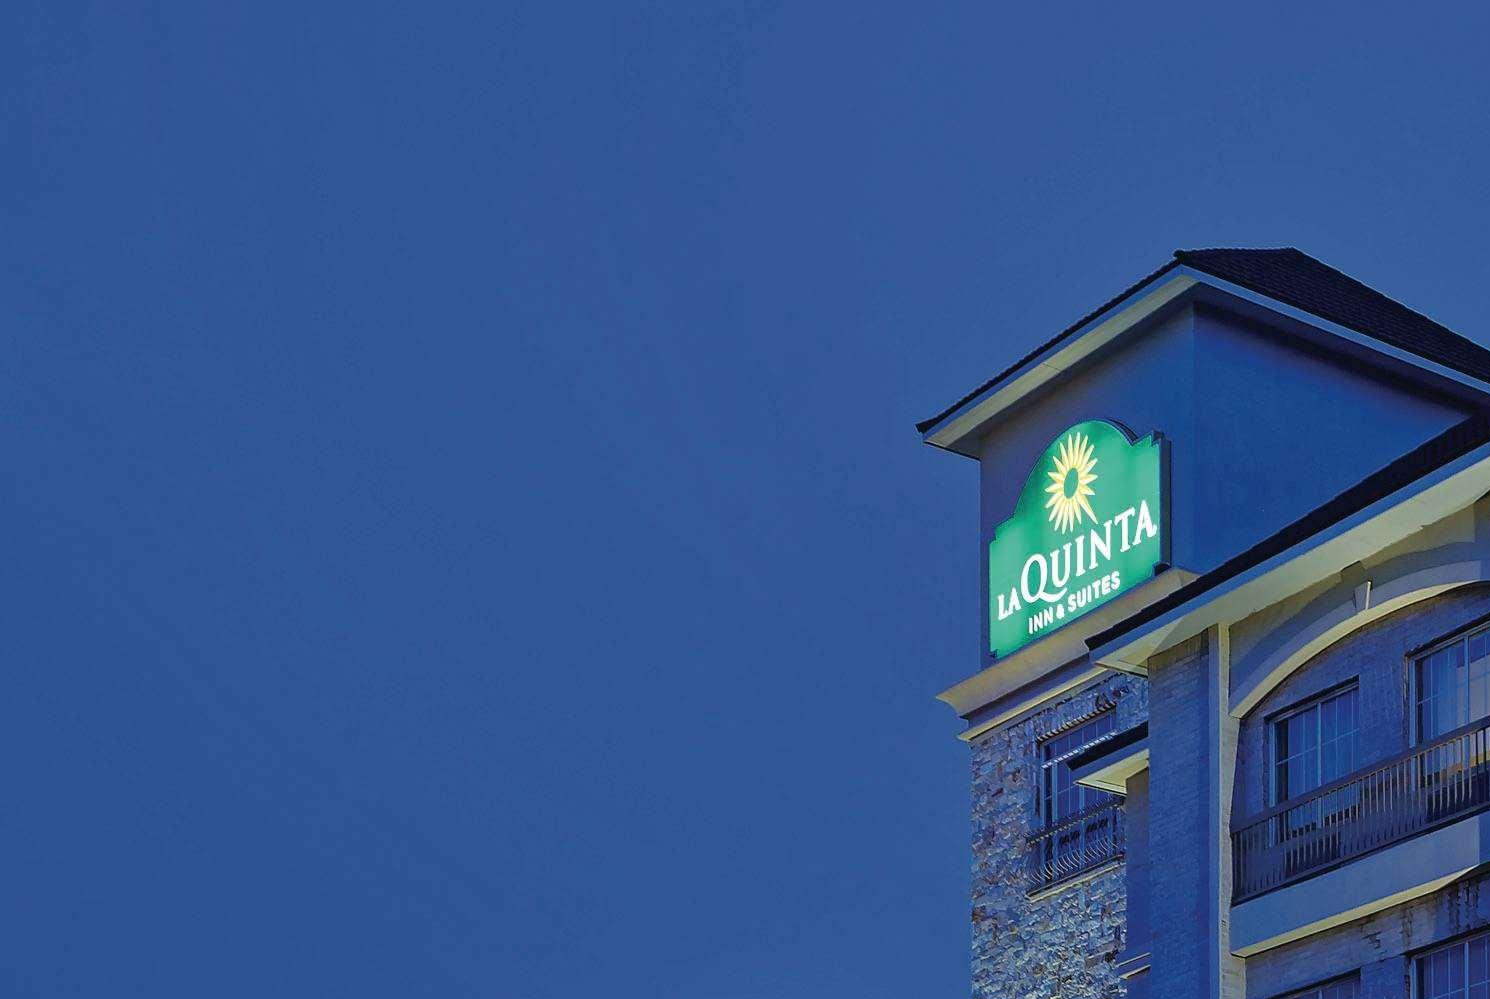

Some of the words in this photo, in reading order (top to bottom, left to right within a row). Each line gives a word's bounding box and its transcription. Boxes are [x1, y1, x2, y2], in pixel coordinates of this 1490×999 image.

[998, 587, 1021, 620] LA
[1020, 499, 1158, 603] QUINTA
[1028, 606, 1054, 635] INN
[1056, 602, 1065, 619] &
[1067, 571, 1121, 613] SUITES
